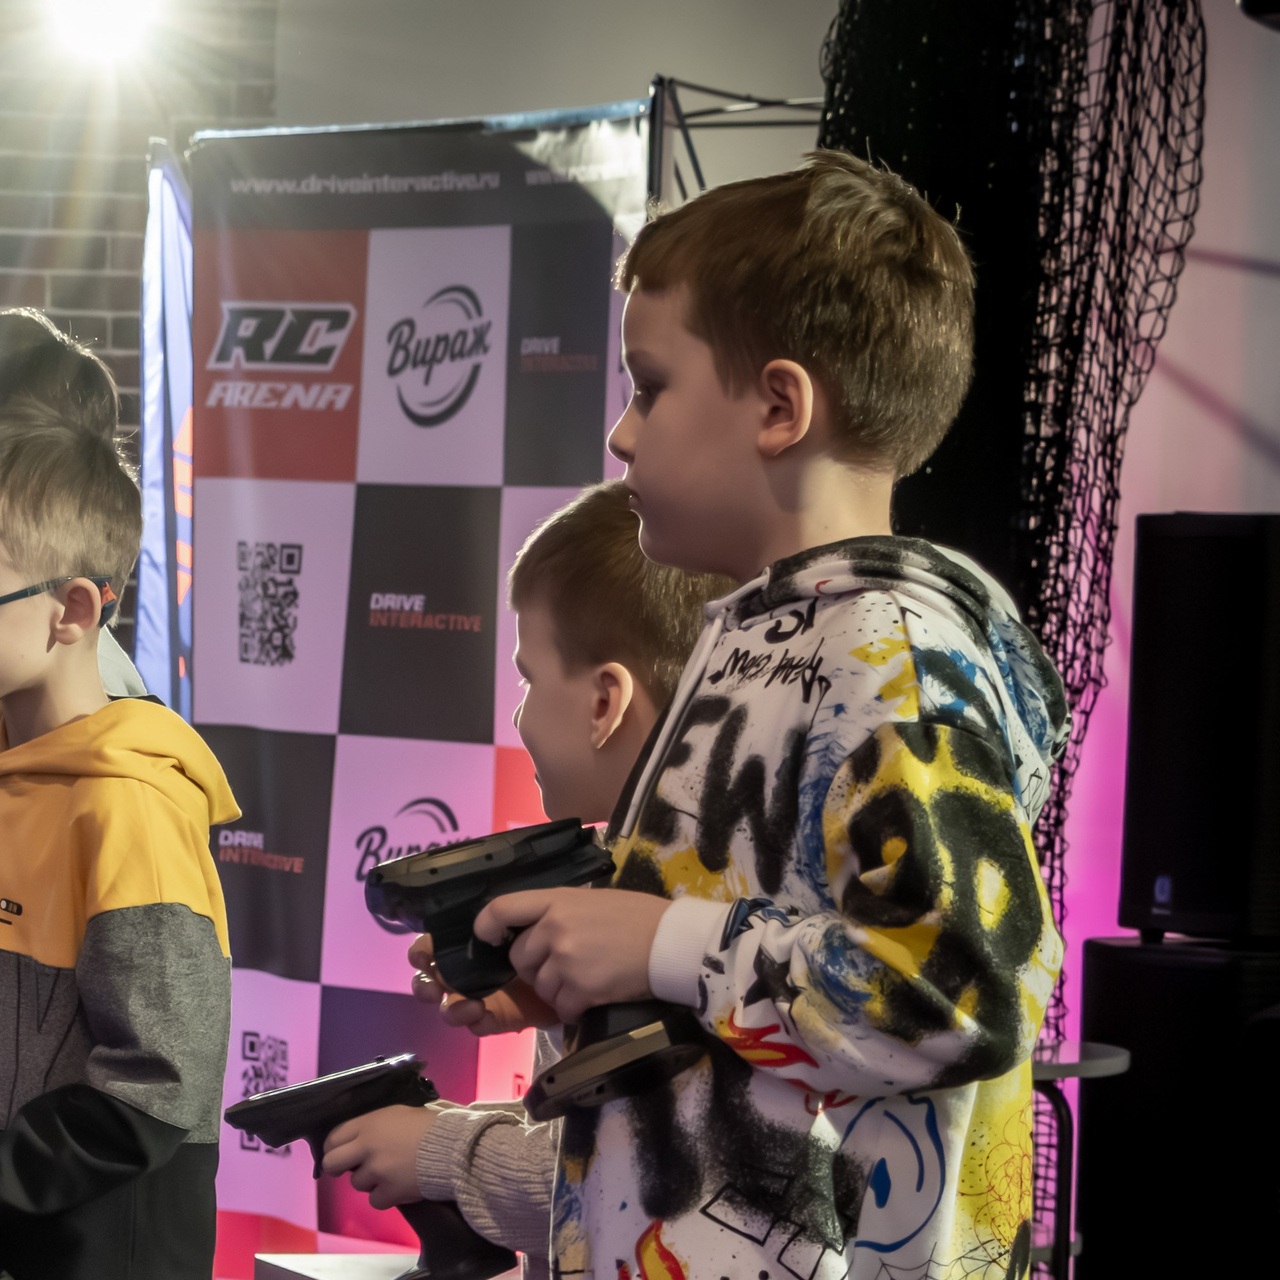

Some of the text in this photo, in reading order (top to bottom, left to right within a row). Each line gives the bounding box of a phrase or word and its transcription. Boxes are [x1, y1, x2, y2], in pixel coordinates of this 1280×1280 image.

[206, 302, 358, 372] RC
[205, 381, 354, 411] ARENA
[370, 592, 426, 612] DRIVE
[369, 610, 481, 633] INTERACTIVE
